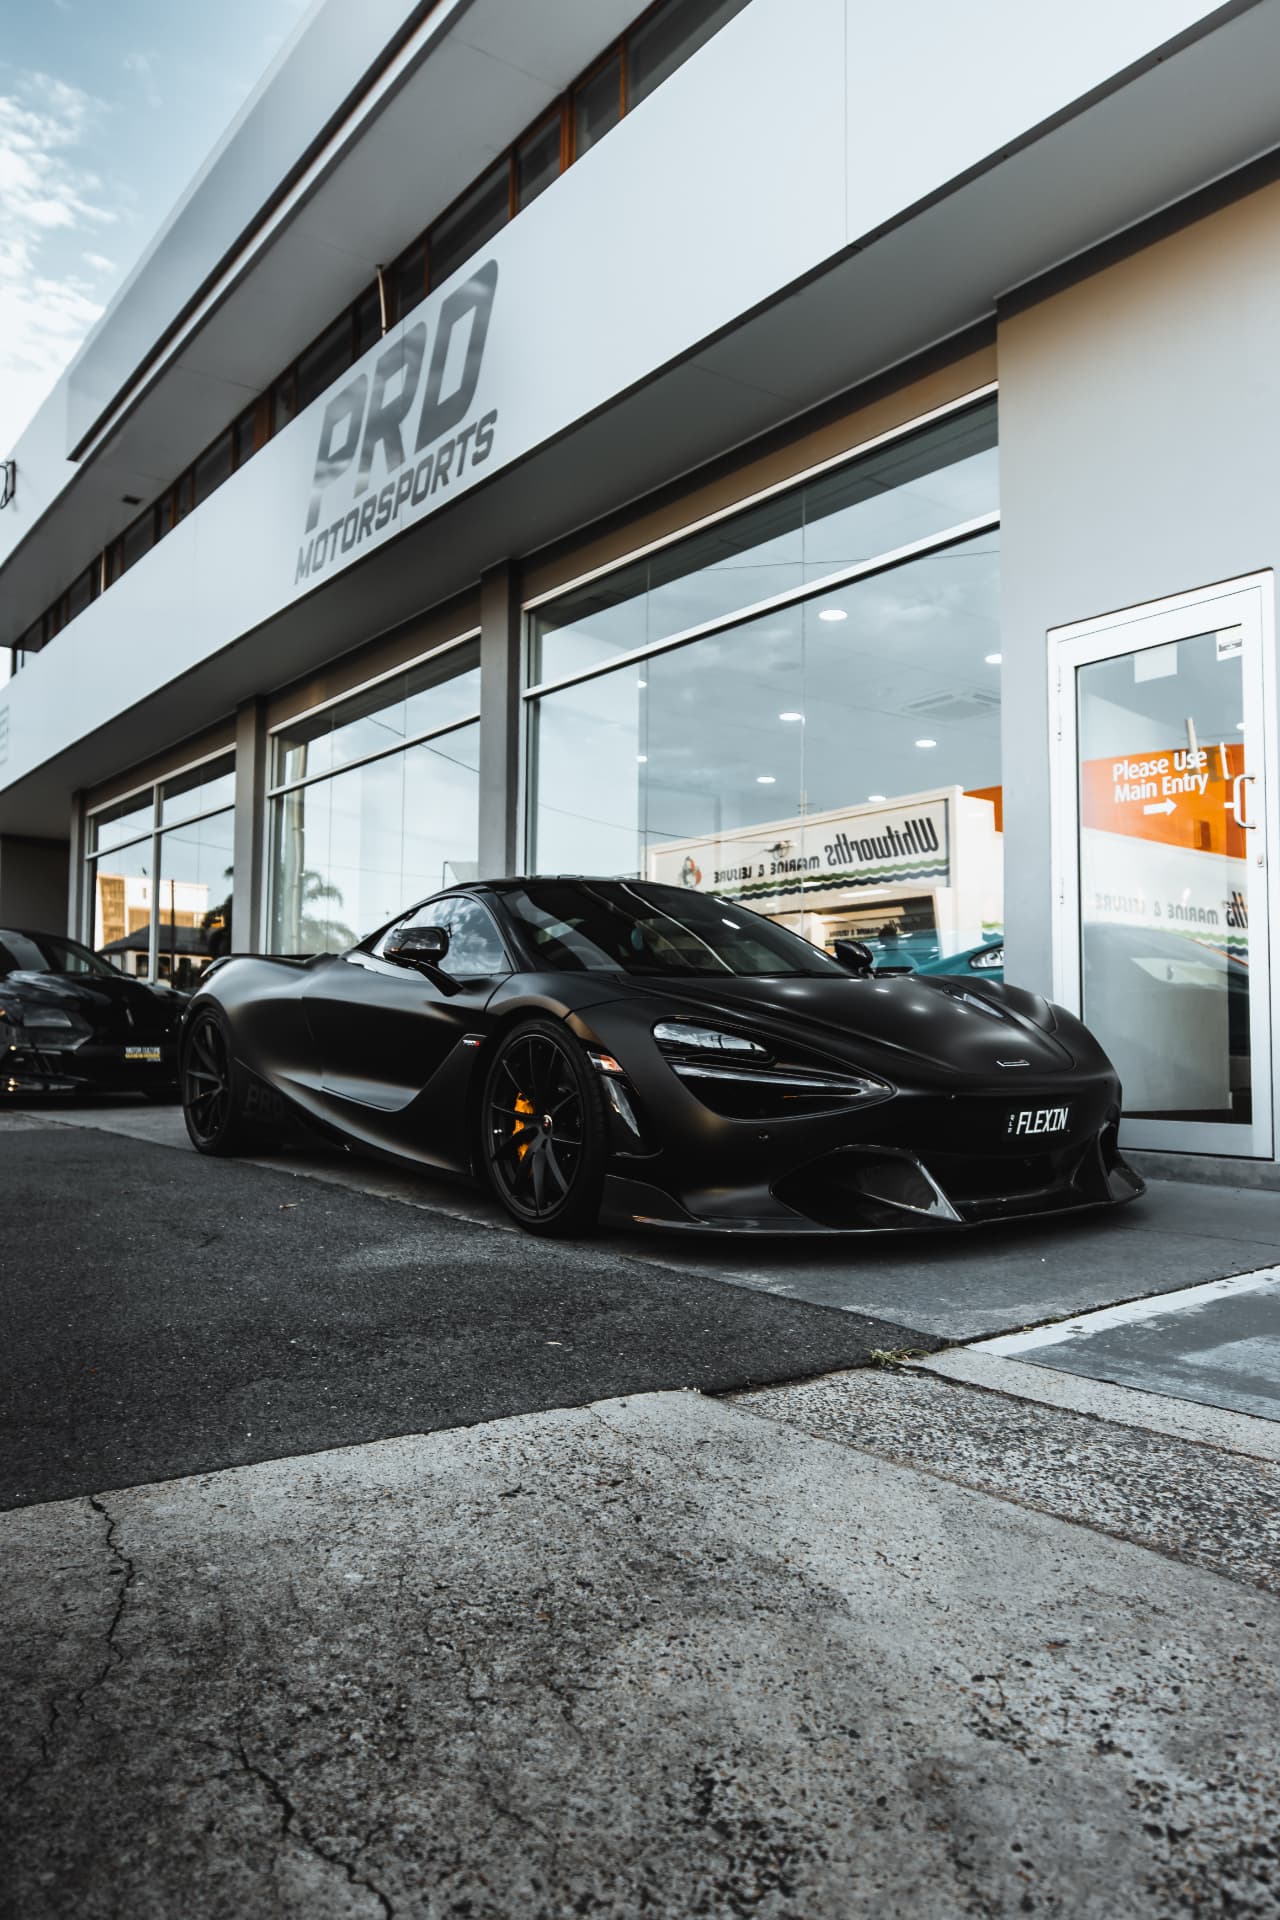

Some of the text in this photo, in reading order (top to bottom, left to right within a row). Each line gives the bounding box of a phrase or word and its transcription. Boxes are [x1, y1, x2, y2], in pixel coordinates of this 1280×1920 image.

[305, 259, 498, 534] PRD
[295, 408, 498, 584] MOTORSPORTS
[1112, 751, 1207, 782] Please Use
[1114, 773, 1209, 803] Main Entry
[1015, 1107, 1069, 1135] FLEXIN
